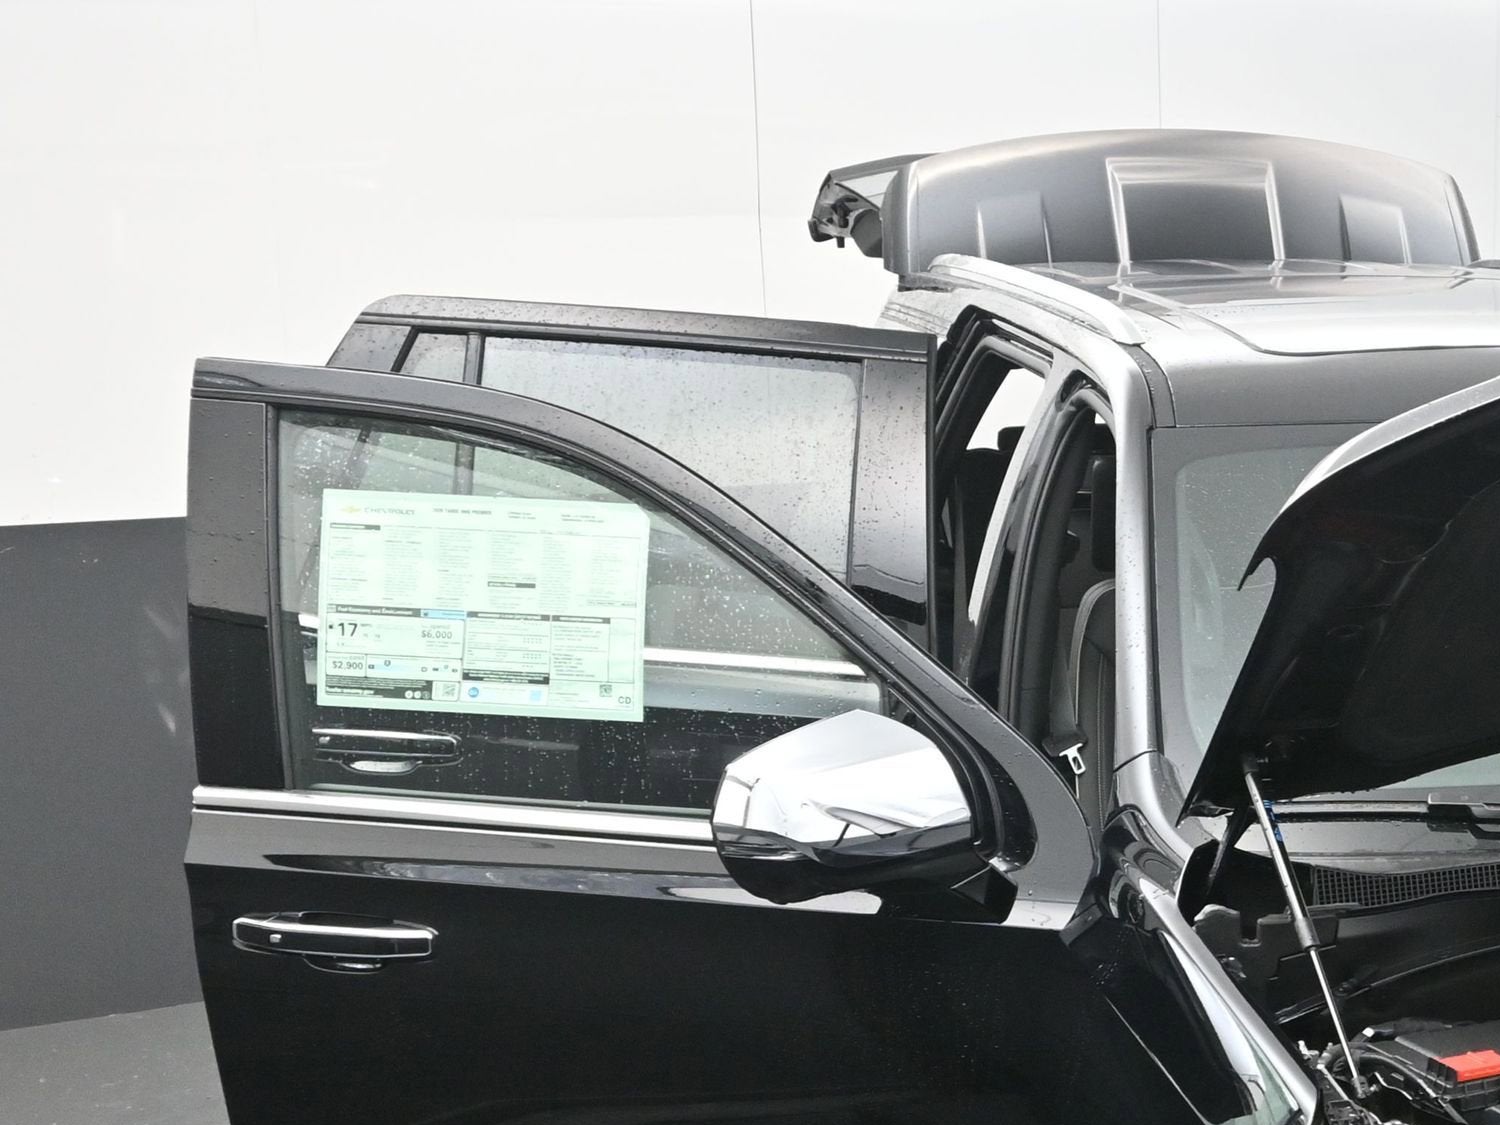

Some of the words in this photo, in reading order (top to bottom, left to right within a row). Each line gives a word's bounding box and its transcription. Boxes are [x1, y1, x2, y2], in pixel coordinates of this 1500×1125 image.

[337, 622, 358, 637] 17
[421, 629, 453, 640] $6,000
[332, 660, 364, 670] $2,900
[617, 696, 632, 705] CD
